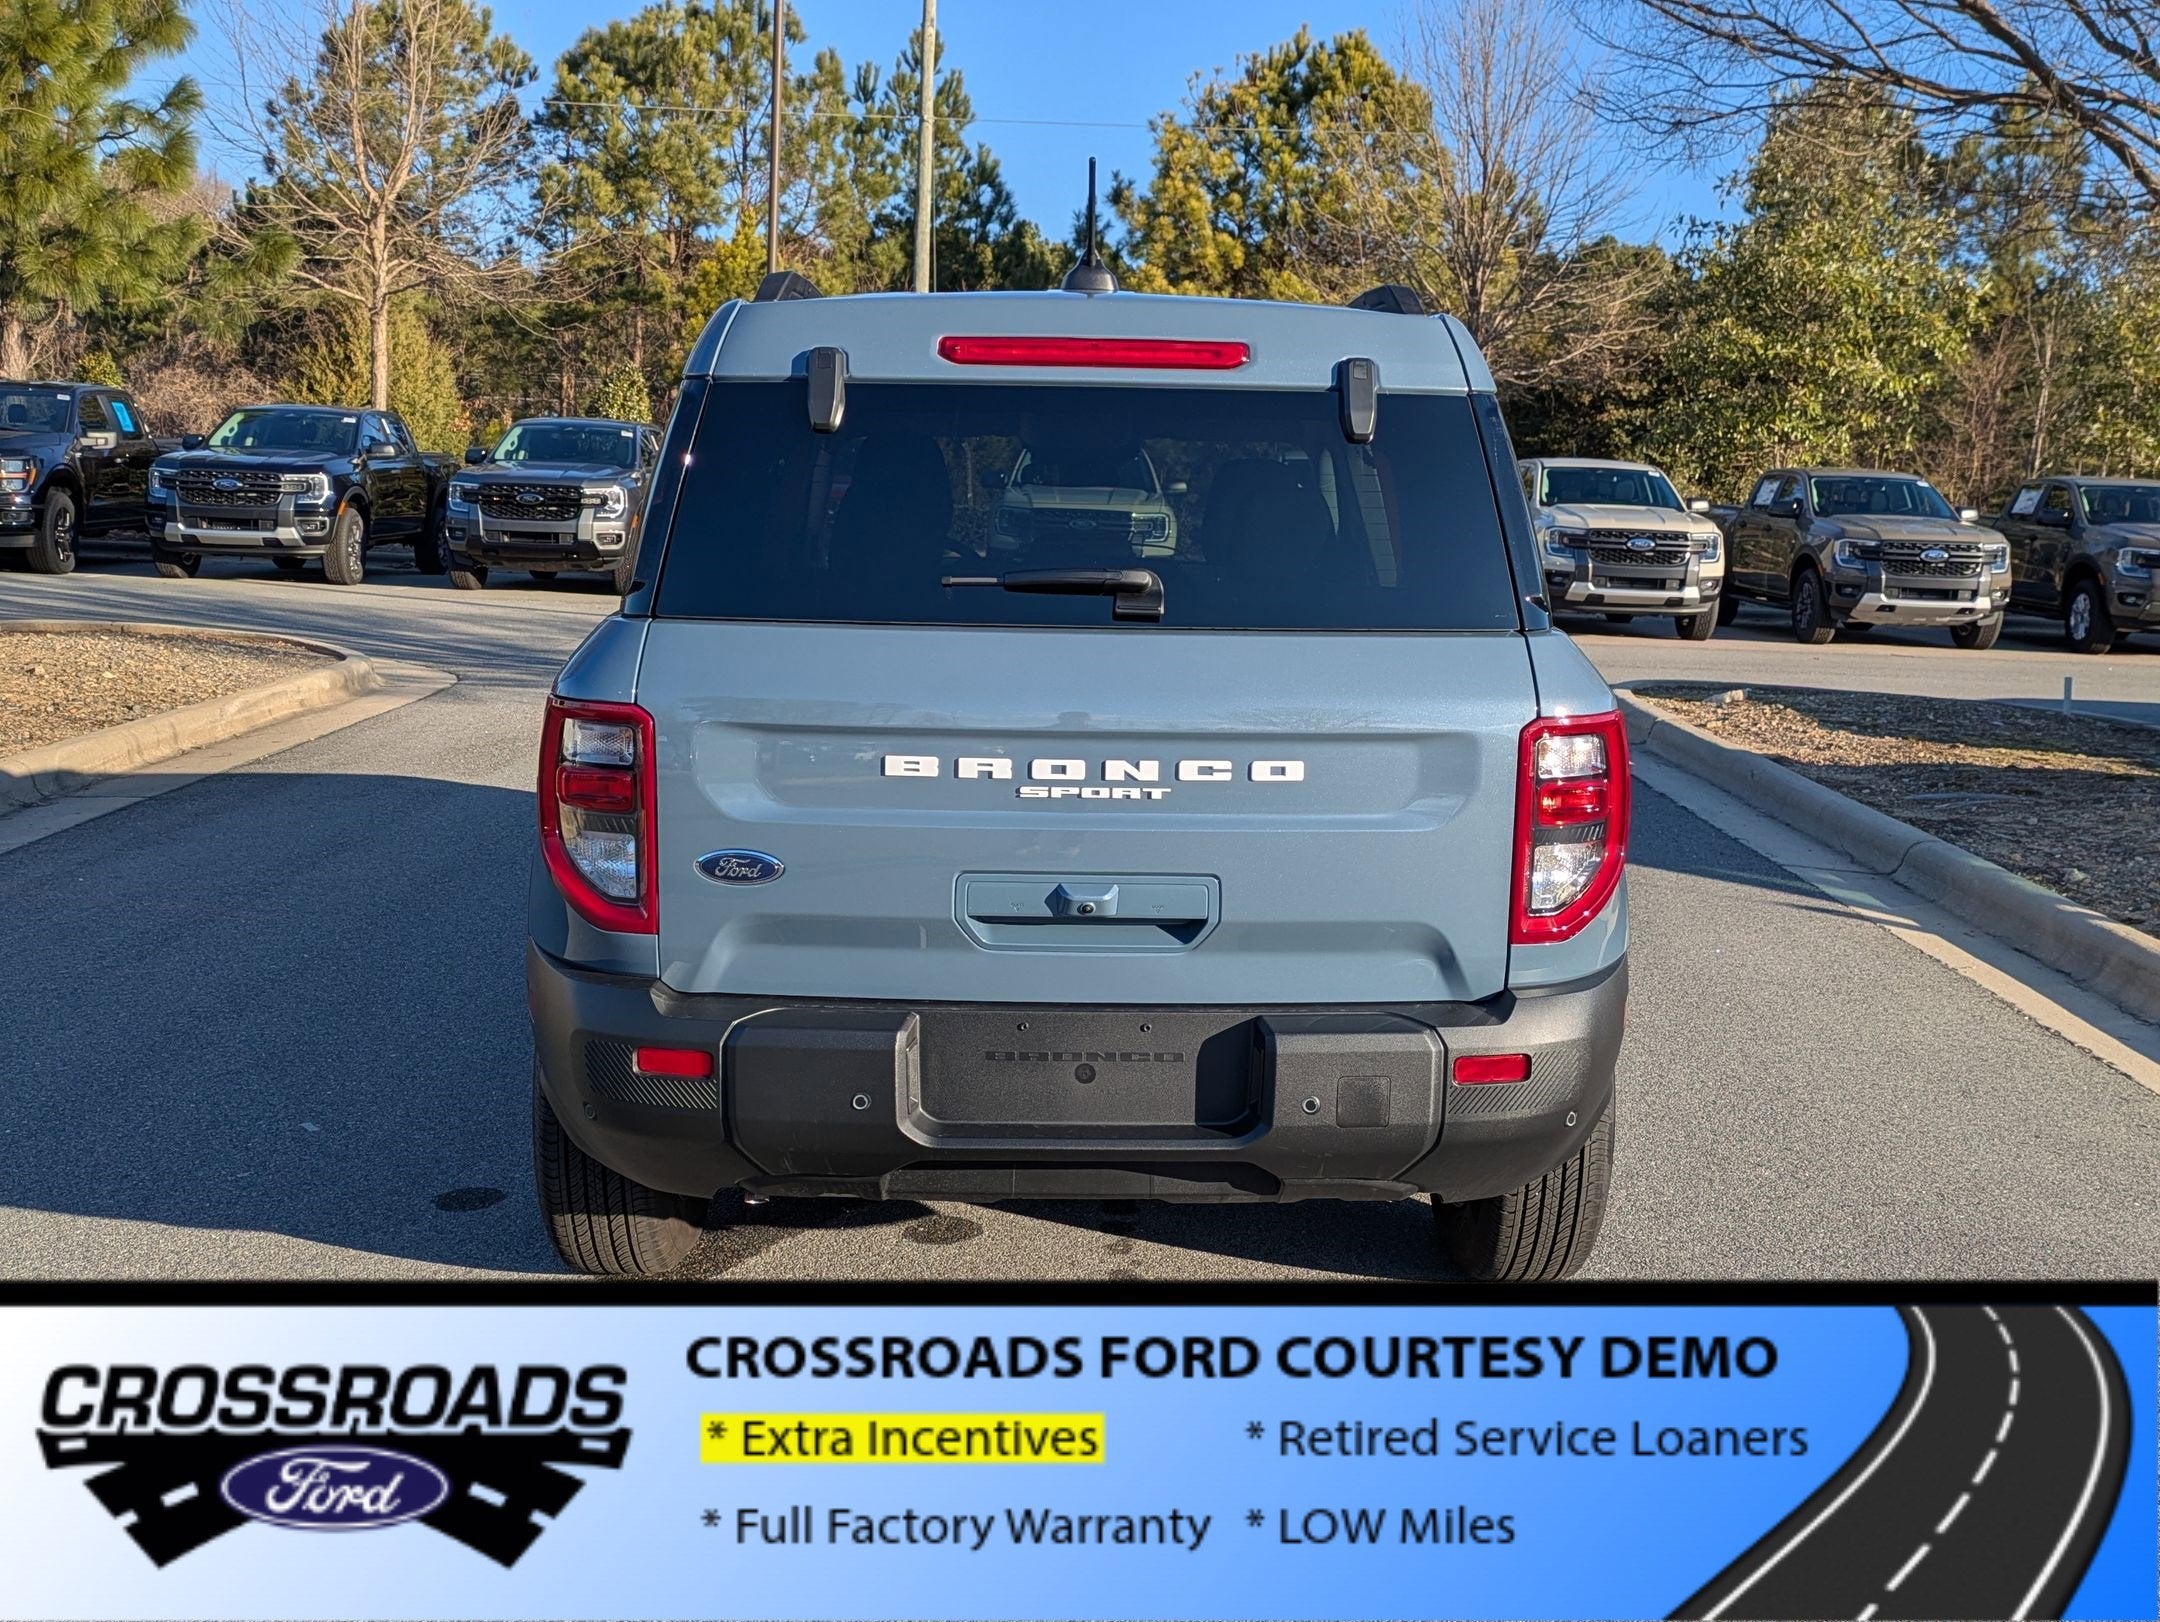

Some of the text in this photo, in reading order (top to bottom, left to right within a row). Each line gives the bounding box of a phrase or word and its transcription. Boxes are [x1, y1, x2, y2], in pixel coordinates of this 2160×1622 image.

[882, 754, 1305, 782] BRONCO
[1016, 786, 1172, 800] SPORT
[714, 856, 762, 878] Ford
[984, 1050, 1186, 1063] BRONCO
